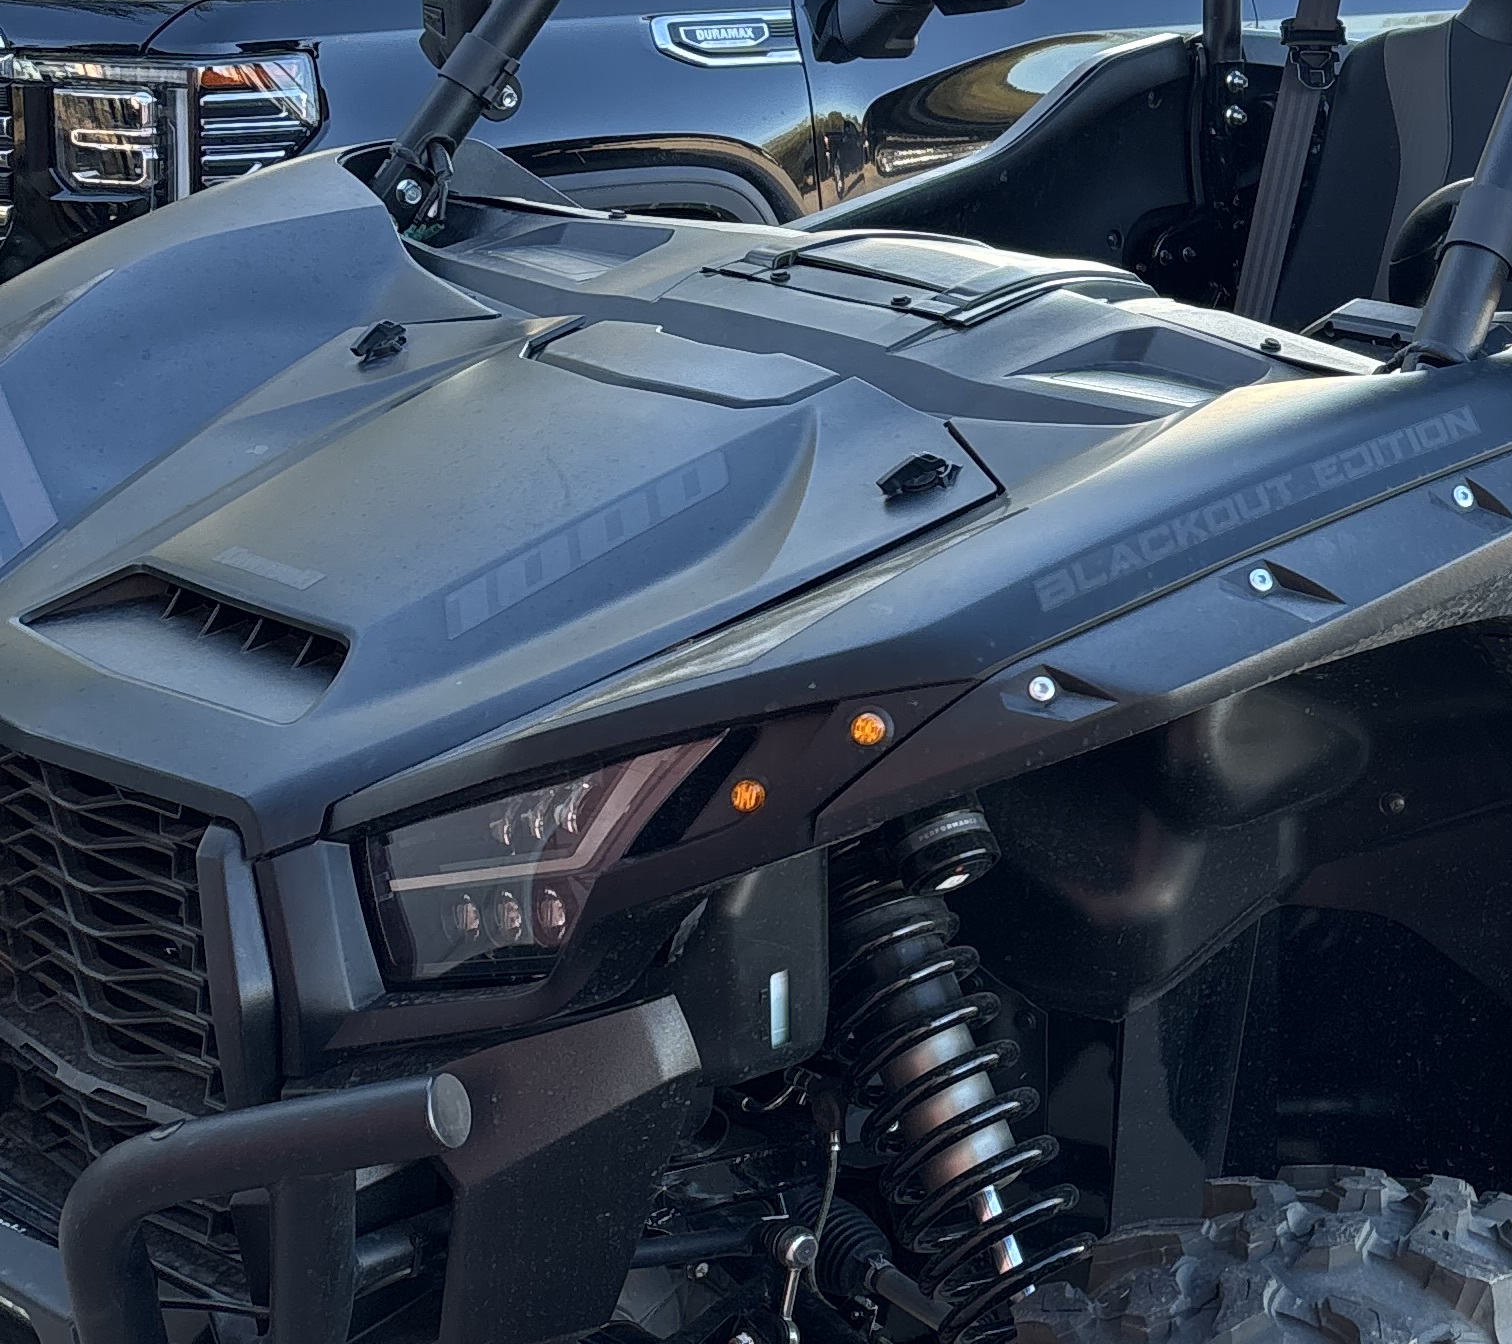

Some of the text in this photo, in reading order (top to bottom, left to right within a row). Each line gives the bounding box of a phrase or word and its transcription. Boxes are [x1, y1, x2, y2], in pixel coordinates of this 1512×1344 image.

[695, 27, 755, 40] DURAMAX
[445, 452, 729, 641] 1000
[1031, 404, 1482, 612] BLACKOUT EDITION
